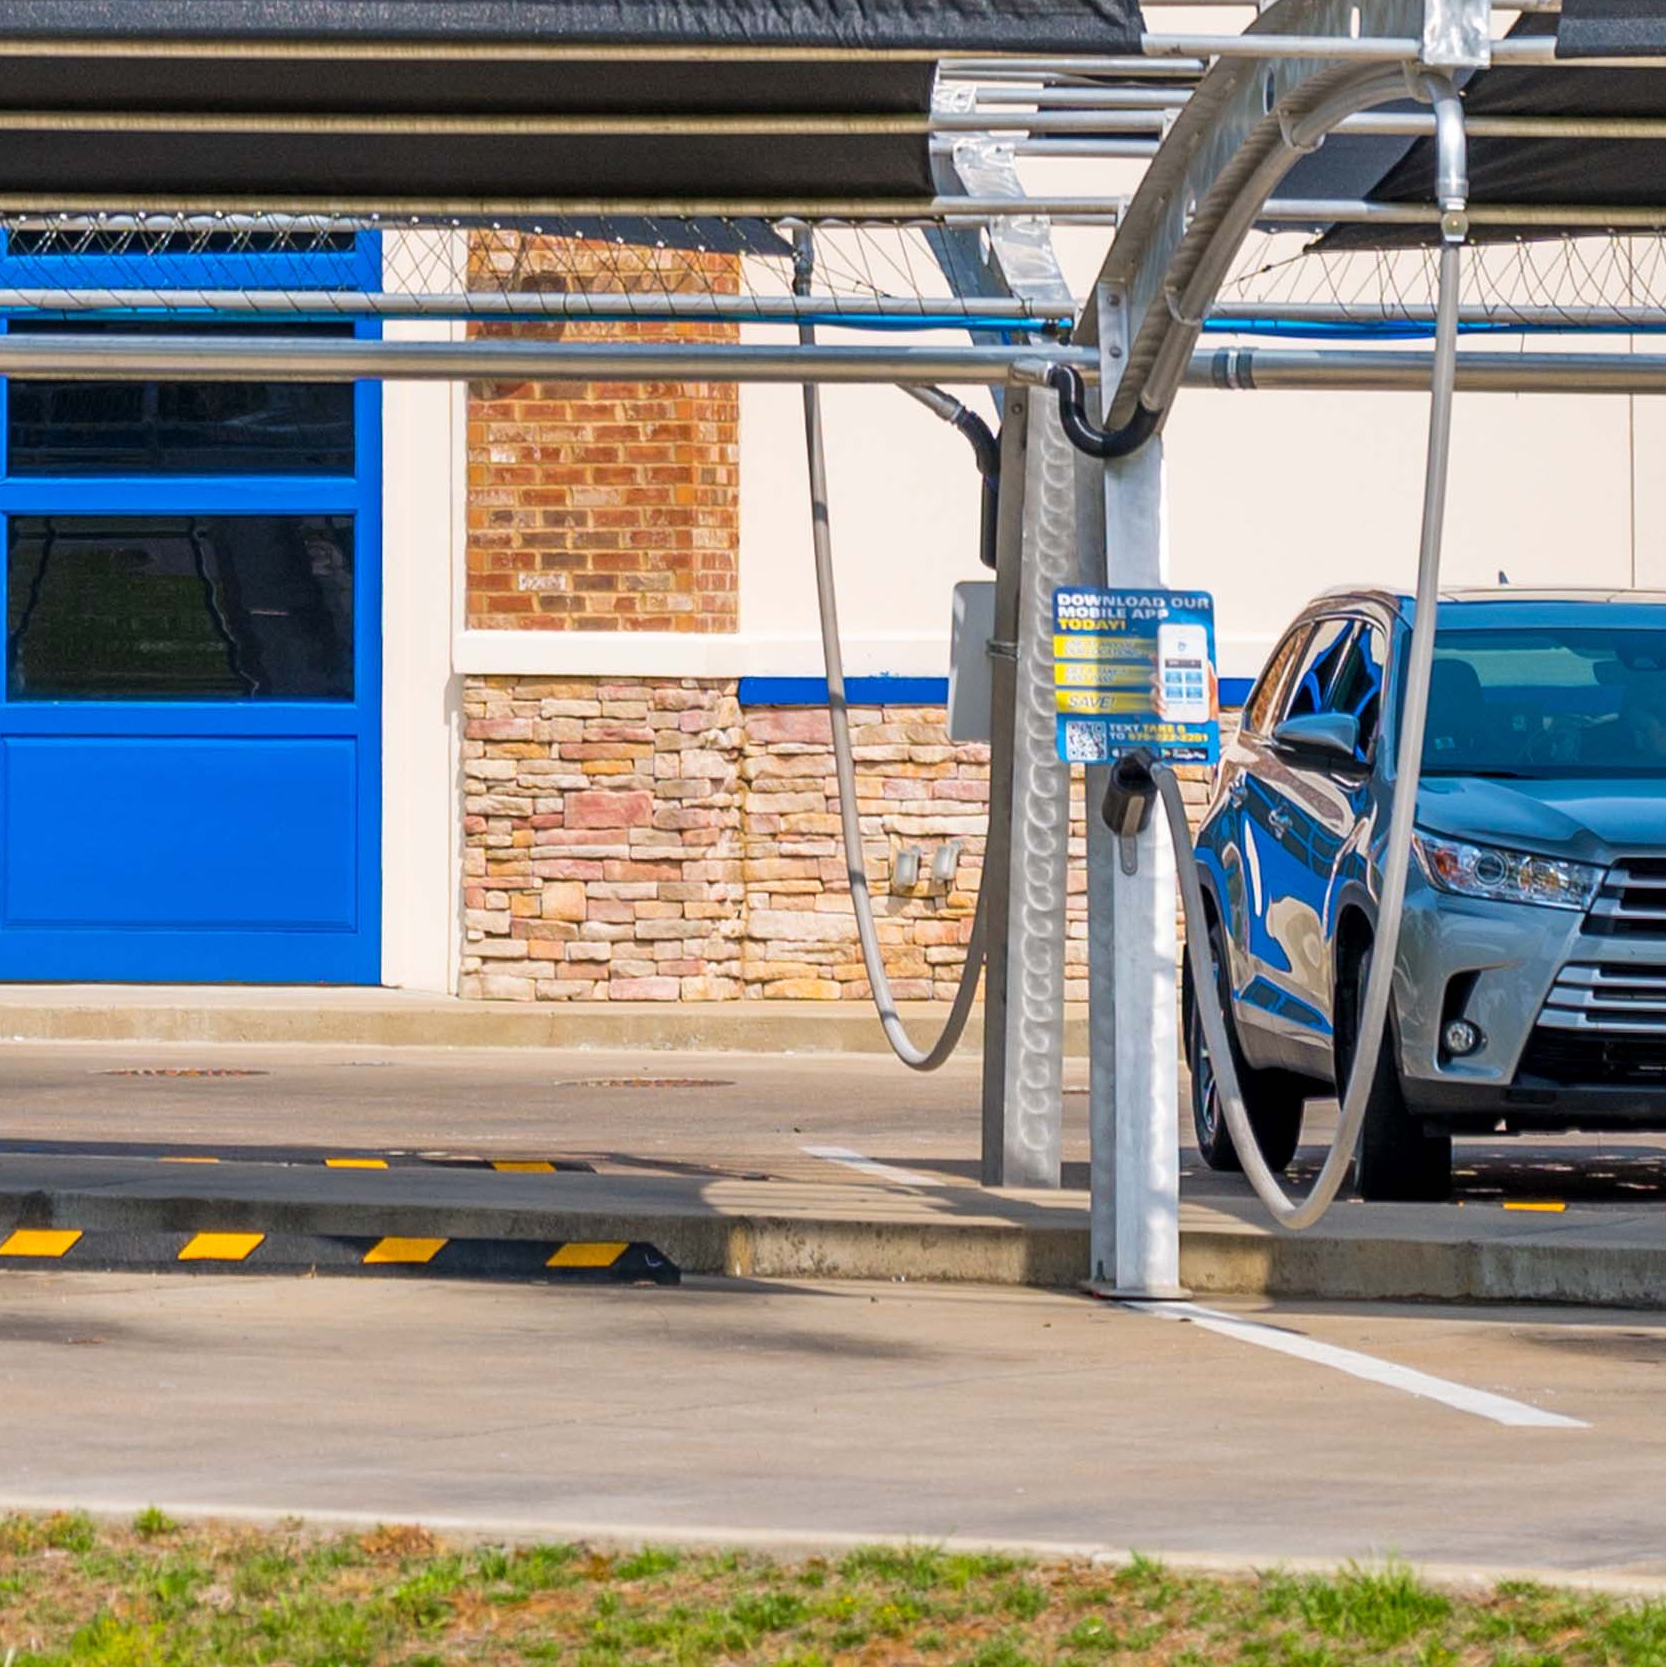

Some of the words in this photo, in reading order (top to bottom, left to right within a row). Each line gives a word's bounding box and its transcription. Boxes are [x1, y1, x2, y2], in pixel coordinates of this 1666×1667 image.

[1057, 594, 1166, 607] DOWNLOAD
[1171, 597, 1210, 609] OUR
[1057, 607, 1127, 619] MOBILE
[1131, 609, 1170, 619] APP
[1057, 619, 1127, 630] TODAY!
[1069, 695, 1117, 708] SAVE!
[1110, 723, 1140, 732] TEXT
[1143, 723, 1174, 733] TAKE
[1110, 732, 1126, 740] TO
